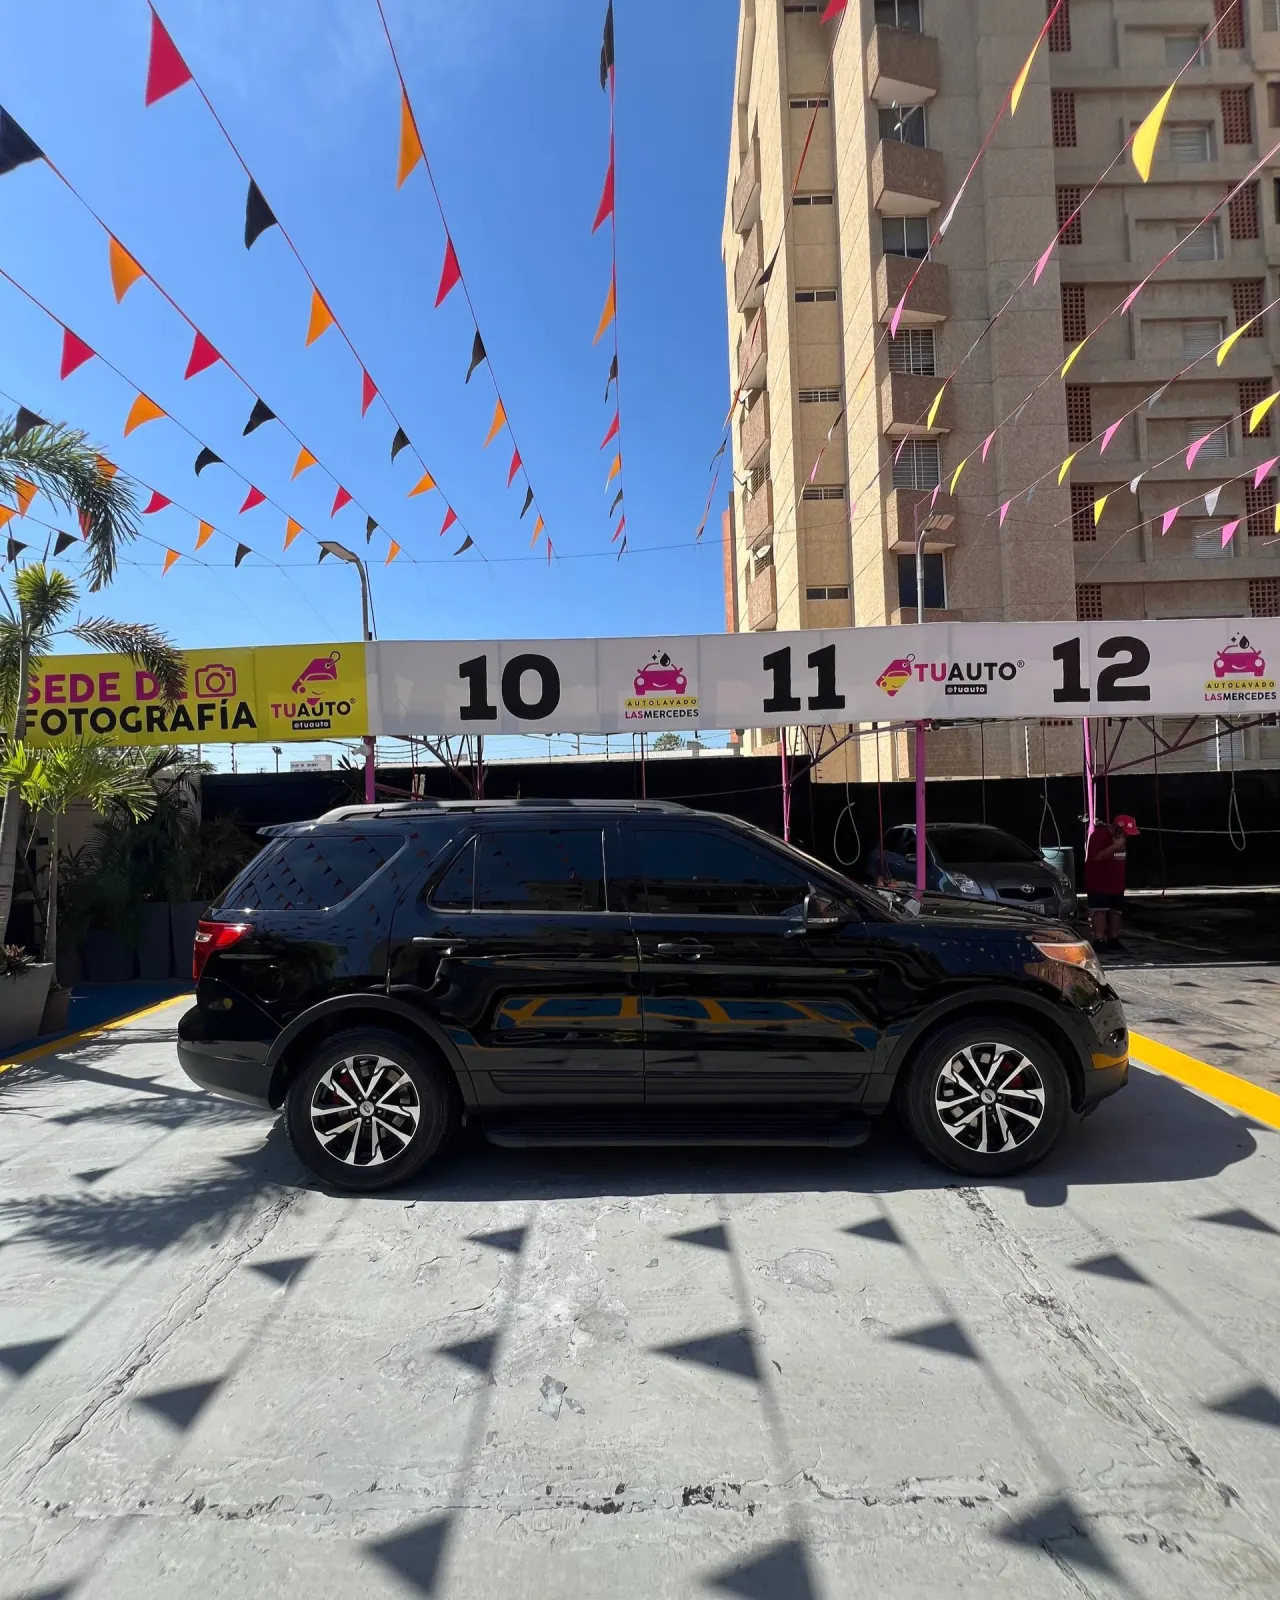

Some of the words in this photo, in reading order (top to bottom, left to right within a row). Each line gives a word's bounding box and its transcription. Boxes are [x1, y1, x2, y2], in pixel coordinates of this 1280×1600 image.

[763, 643, 846, 713] 11
[1053, 635, 1151, 703] 12
[27, 672, 121, 704] SEDE
[459, 653, 561, 721] 10
[947, 685, 986, 694] @tuauto
[1206, 681, 1276, 689] AUTOLAVADO
[627, 699, 697, 707] AUTOLAVADO
[1204, 691, 1277, 702] LASMERCEDES
[24, 698, 257, 736] FOTOGRAFÍA
[624, 708, 700, 719] LASMERCEDES
